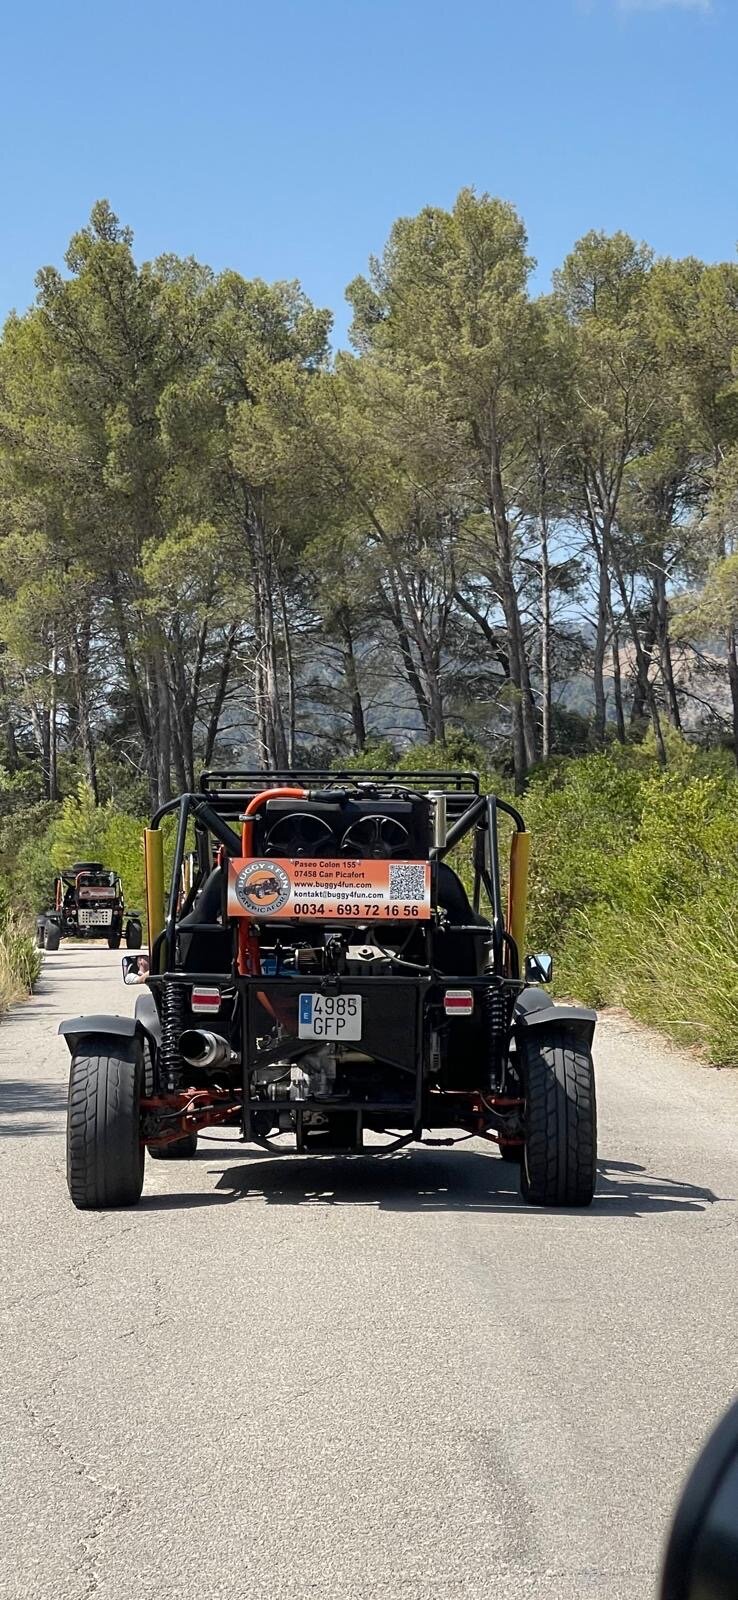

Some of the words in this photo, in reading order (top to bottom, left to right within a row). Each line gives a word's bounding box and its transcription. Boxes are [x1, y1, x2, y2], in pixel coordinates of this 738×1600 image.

[238, 863, 265, 888] BUGGY
[275, 868, 289, 889] FUN
[294, 870, 317, 878] 07458
[294, 881, 372, 890] www.buggy4fun.com
[294, 891, 384, 900] kontakt@buggy4fun.com
[294, 903, 325, 915] 0034
[336, 904, 360, 915] 693
[364, 904, 379, 916] 72
[384, 905, 399, 916] 16
[403, 905, 419, 916] 56
[313, 997, 357, 1016] 4985
[303, 1012, 309, 1020] E
[313, 1017, 346, 1036] GFP
